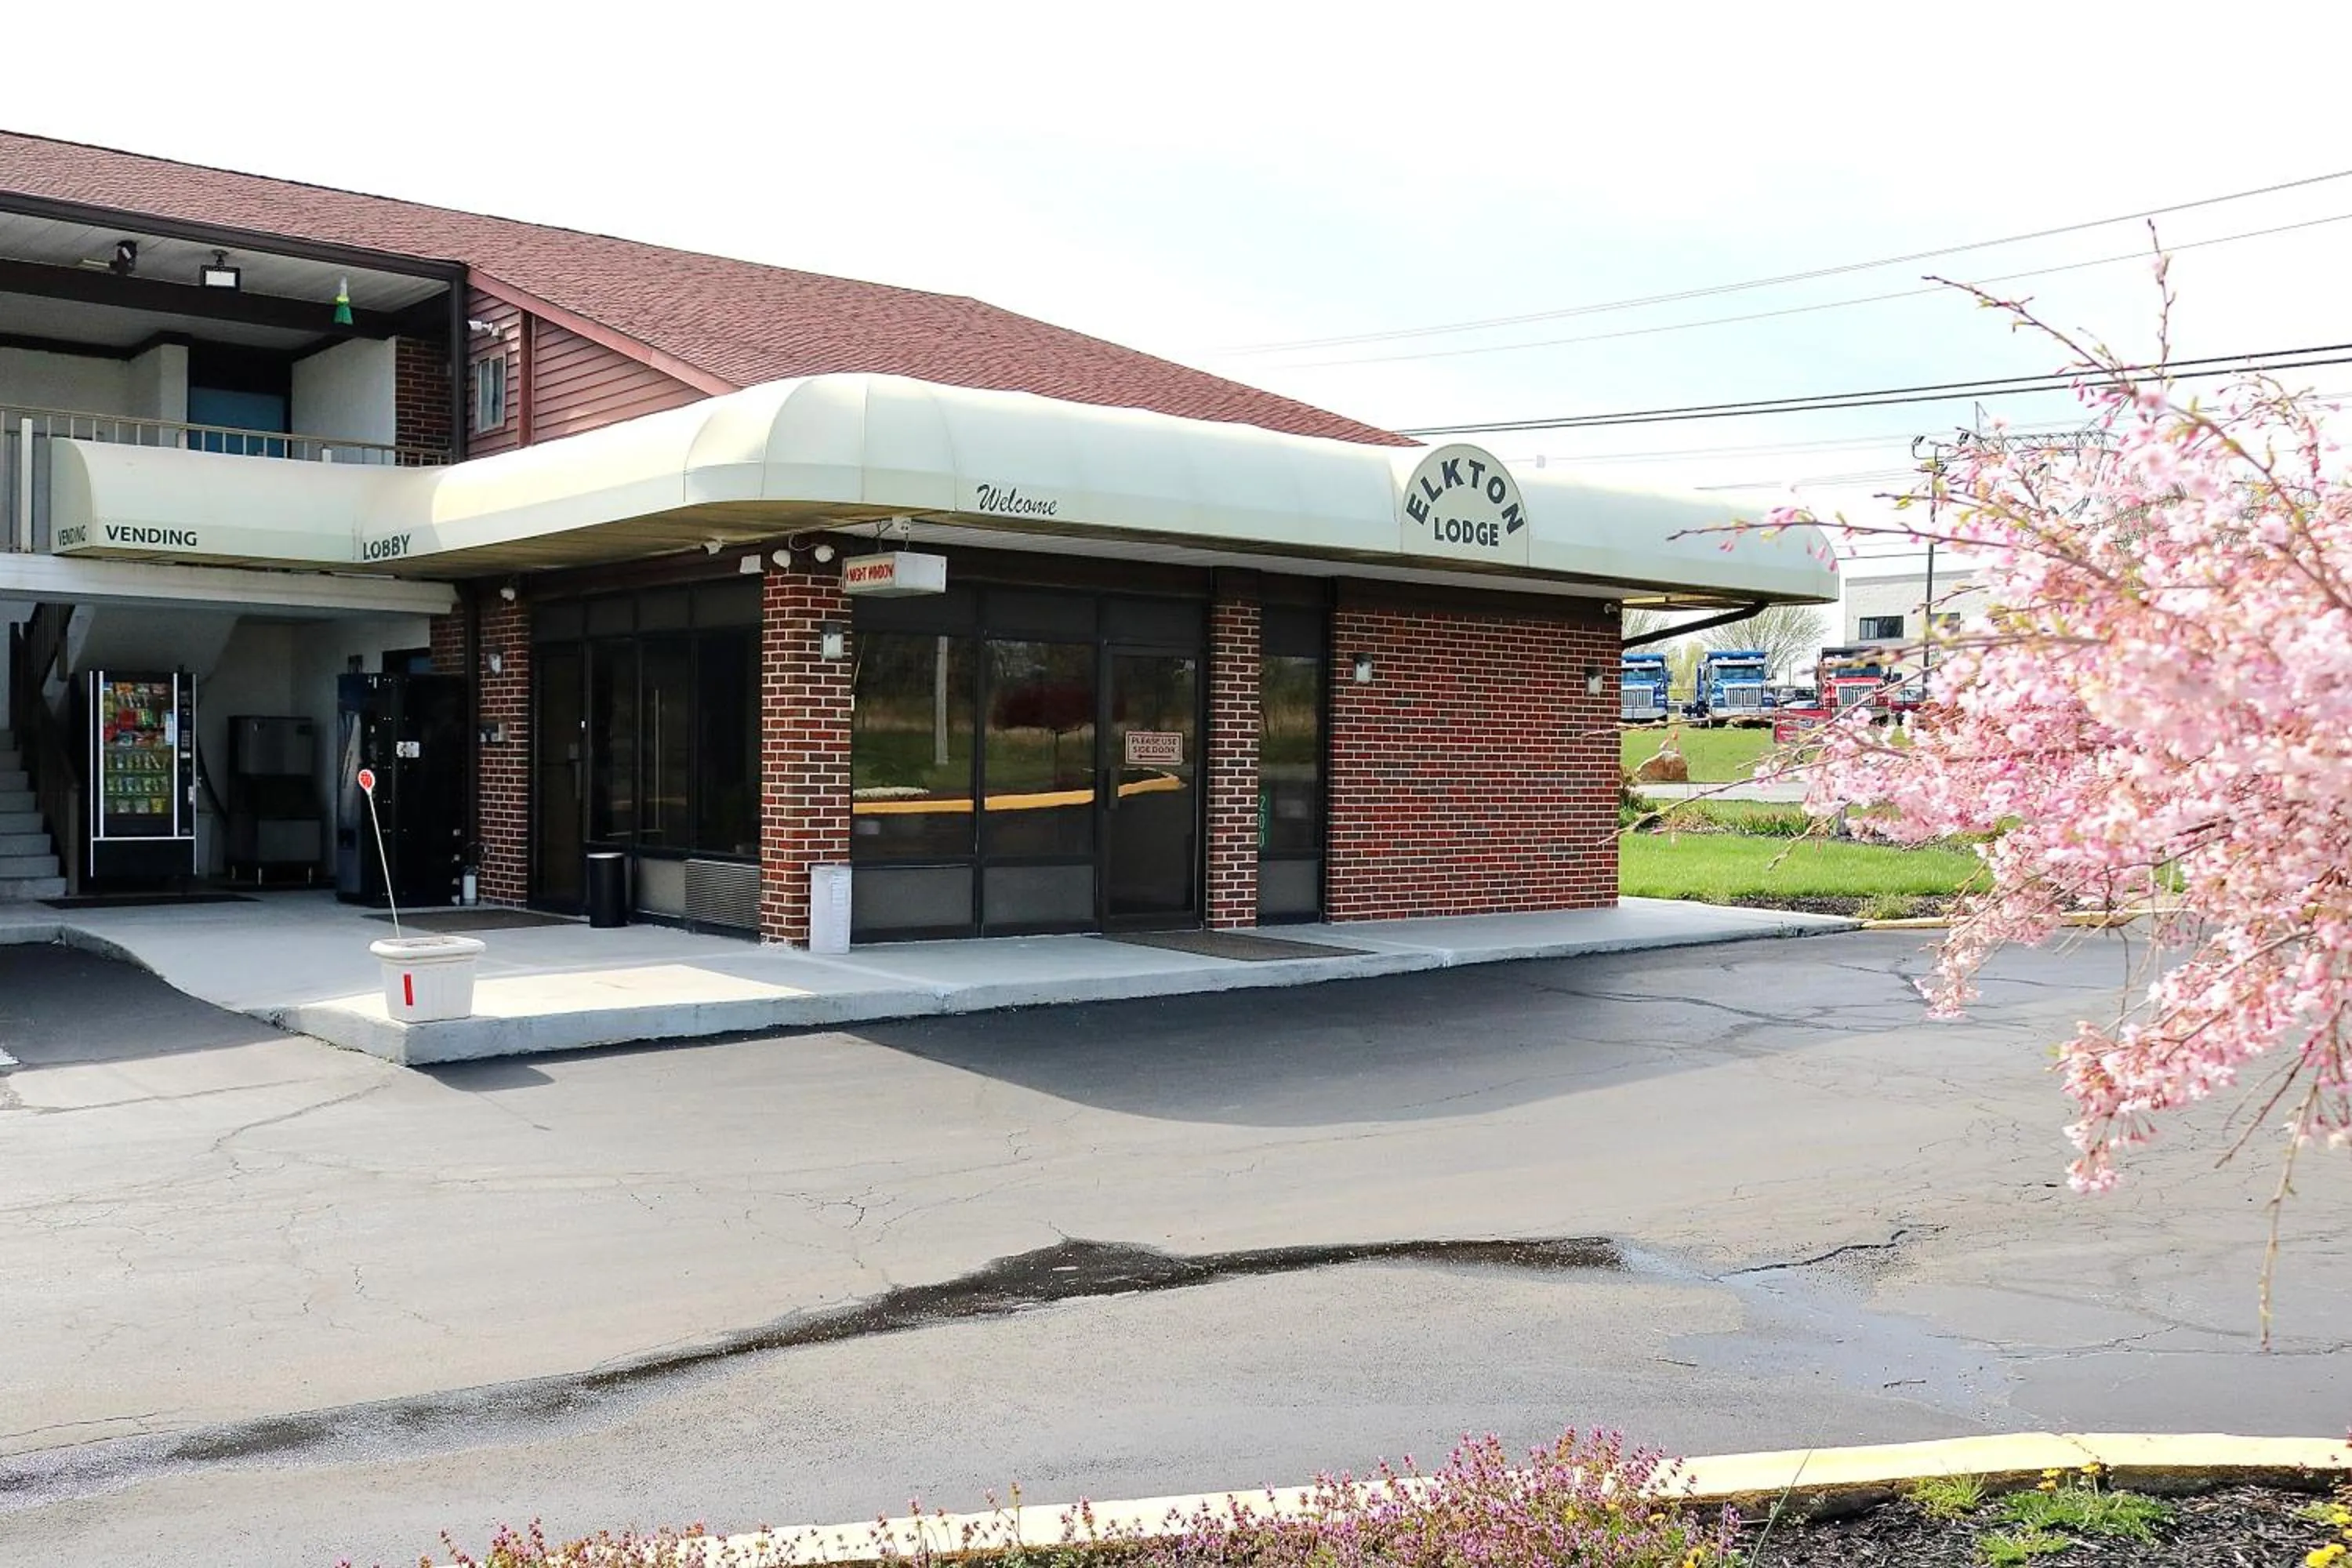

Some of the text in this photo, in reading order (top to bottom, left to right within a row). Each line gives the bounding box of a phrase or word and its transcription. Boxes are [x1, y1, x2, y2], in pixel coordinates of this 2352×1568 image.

[977, 484, 1058, 515] Welcome
[1406, 457, 1525, 535] ELKTON
[58, 524, 86, 546] VENDING
[106, 524, 198, 546] VENDING
[1434, 517, 1499, 546] LODGE
[363, 534, 411, 560] LOBBY
[1131, 737, 1160, 746] PLEASE
